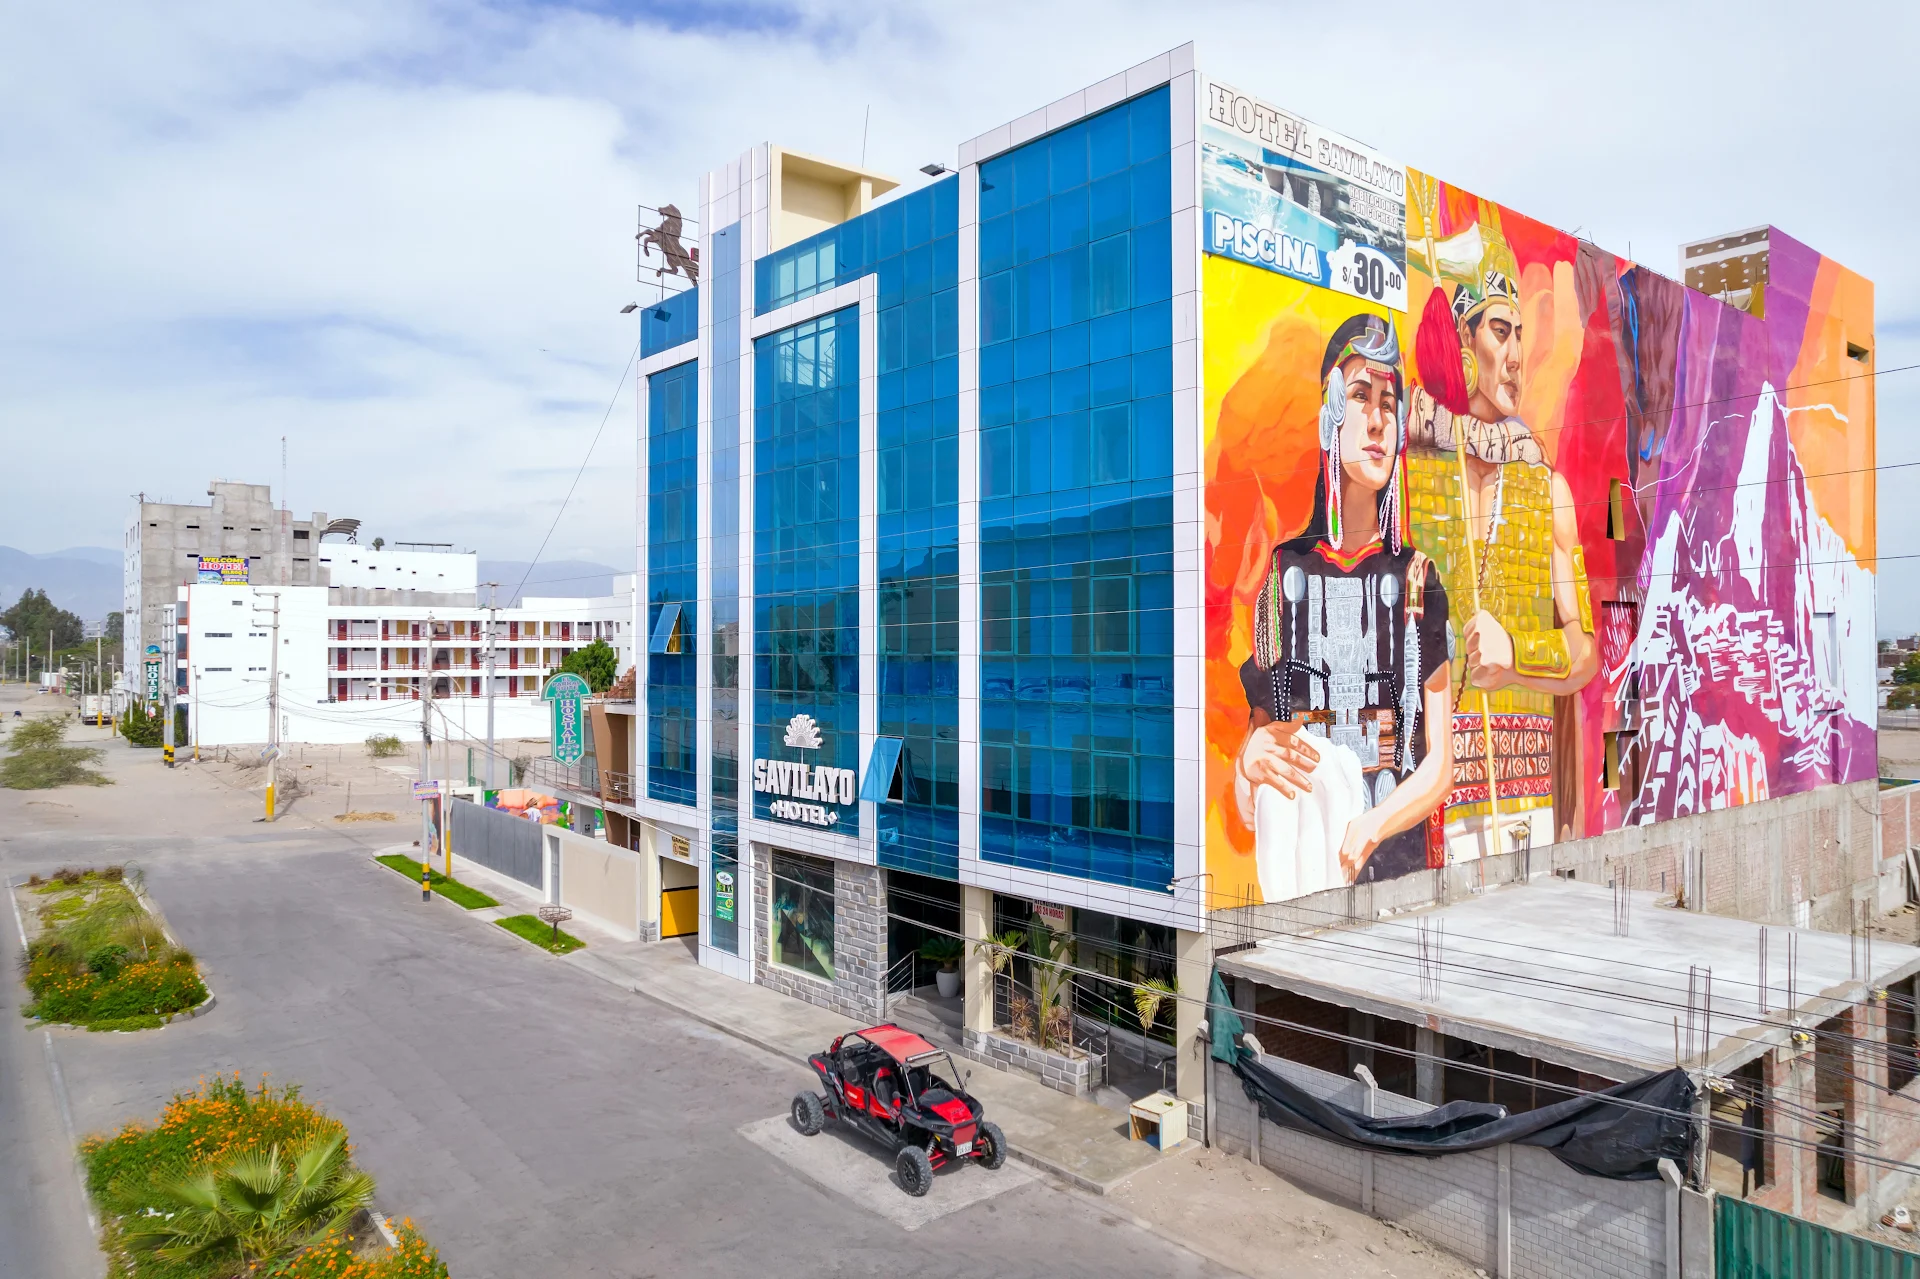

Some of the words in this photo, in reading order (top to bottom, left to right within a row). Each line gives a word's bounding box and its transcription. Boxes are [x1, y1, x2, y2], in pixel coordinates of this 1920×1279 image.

[1209, 83, 1312, 159] HOTEL
[1318, 138, 1404, 197] SAVILAYO
[1349, 185, 1399, 216] HABITACIONES
[1349, 199, 1366, 217] CON
[1367, 206, 1399, 230] COCHERA
[1214, 211, 1321, 280] PISCINA
[199, 562, 248, 570] HOTEL
[147, 664, 158, 700] HOTEL
[560, 699, 576, 744] HOSTAL
[754, 758, 855, 806] SAVILAYO
[775, 799, 829, 826] HOTEL
[1049, 908, 1064, 920] HORAS
